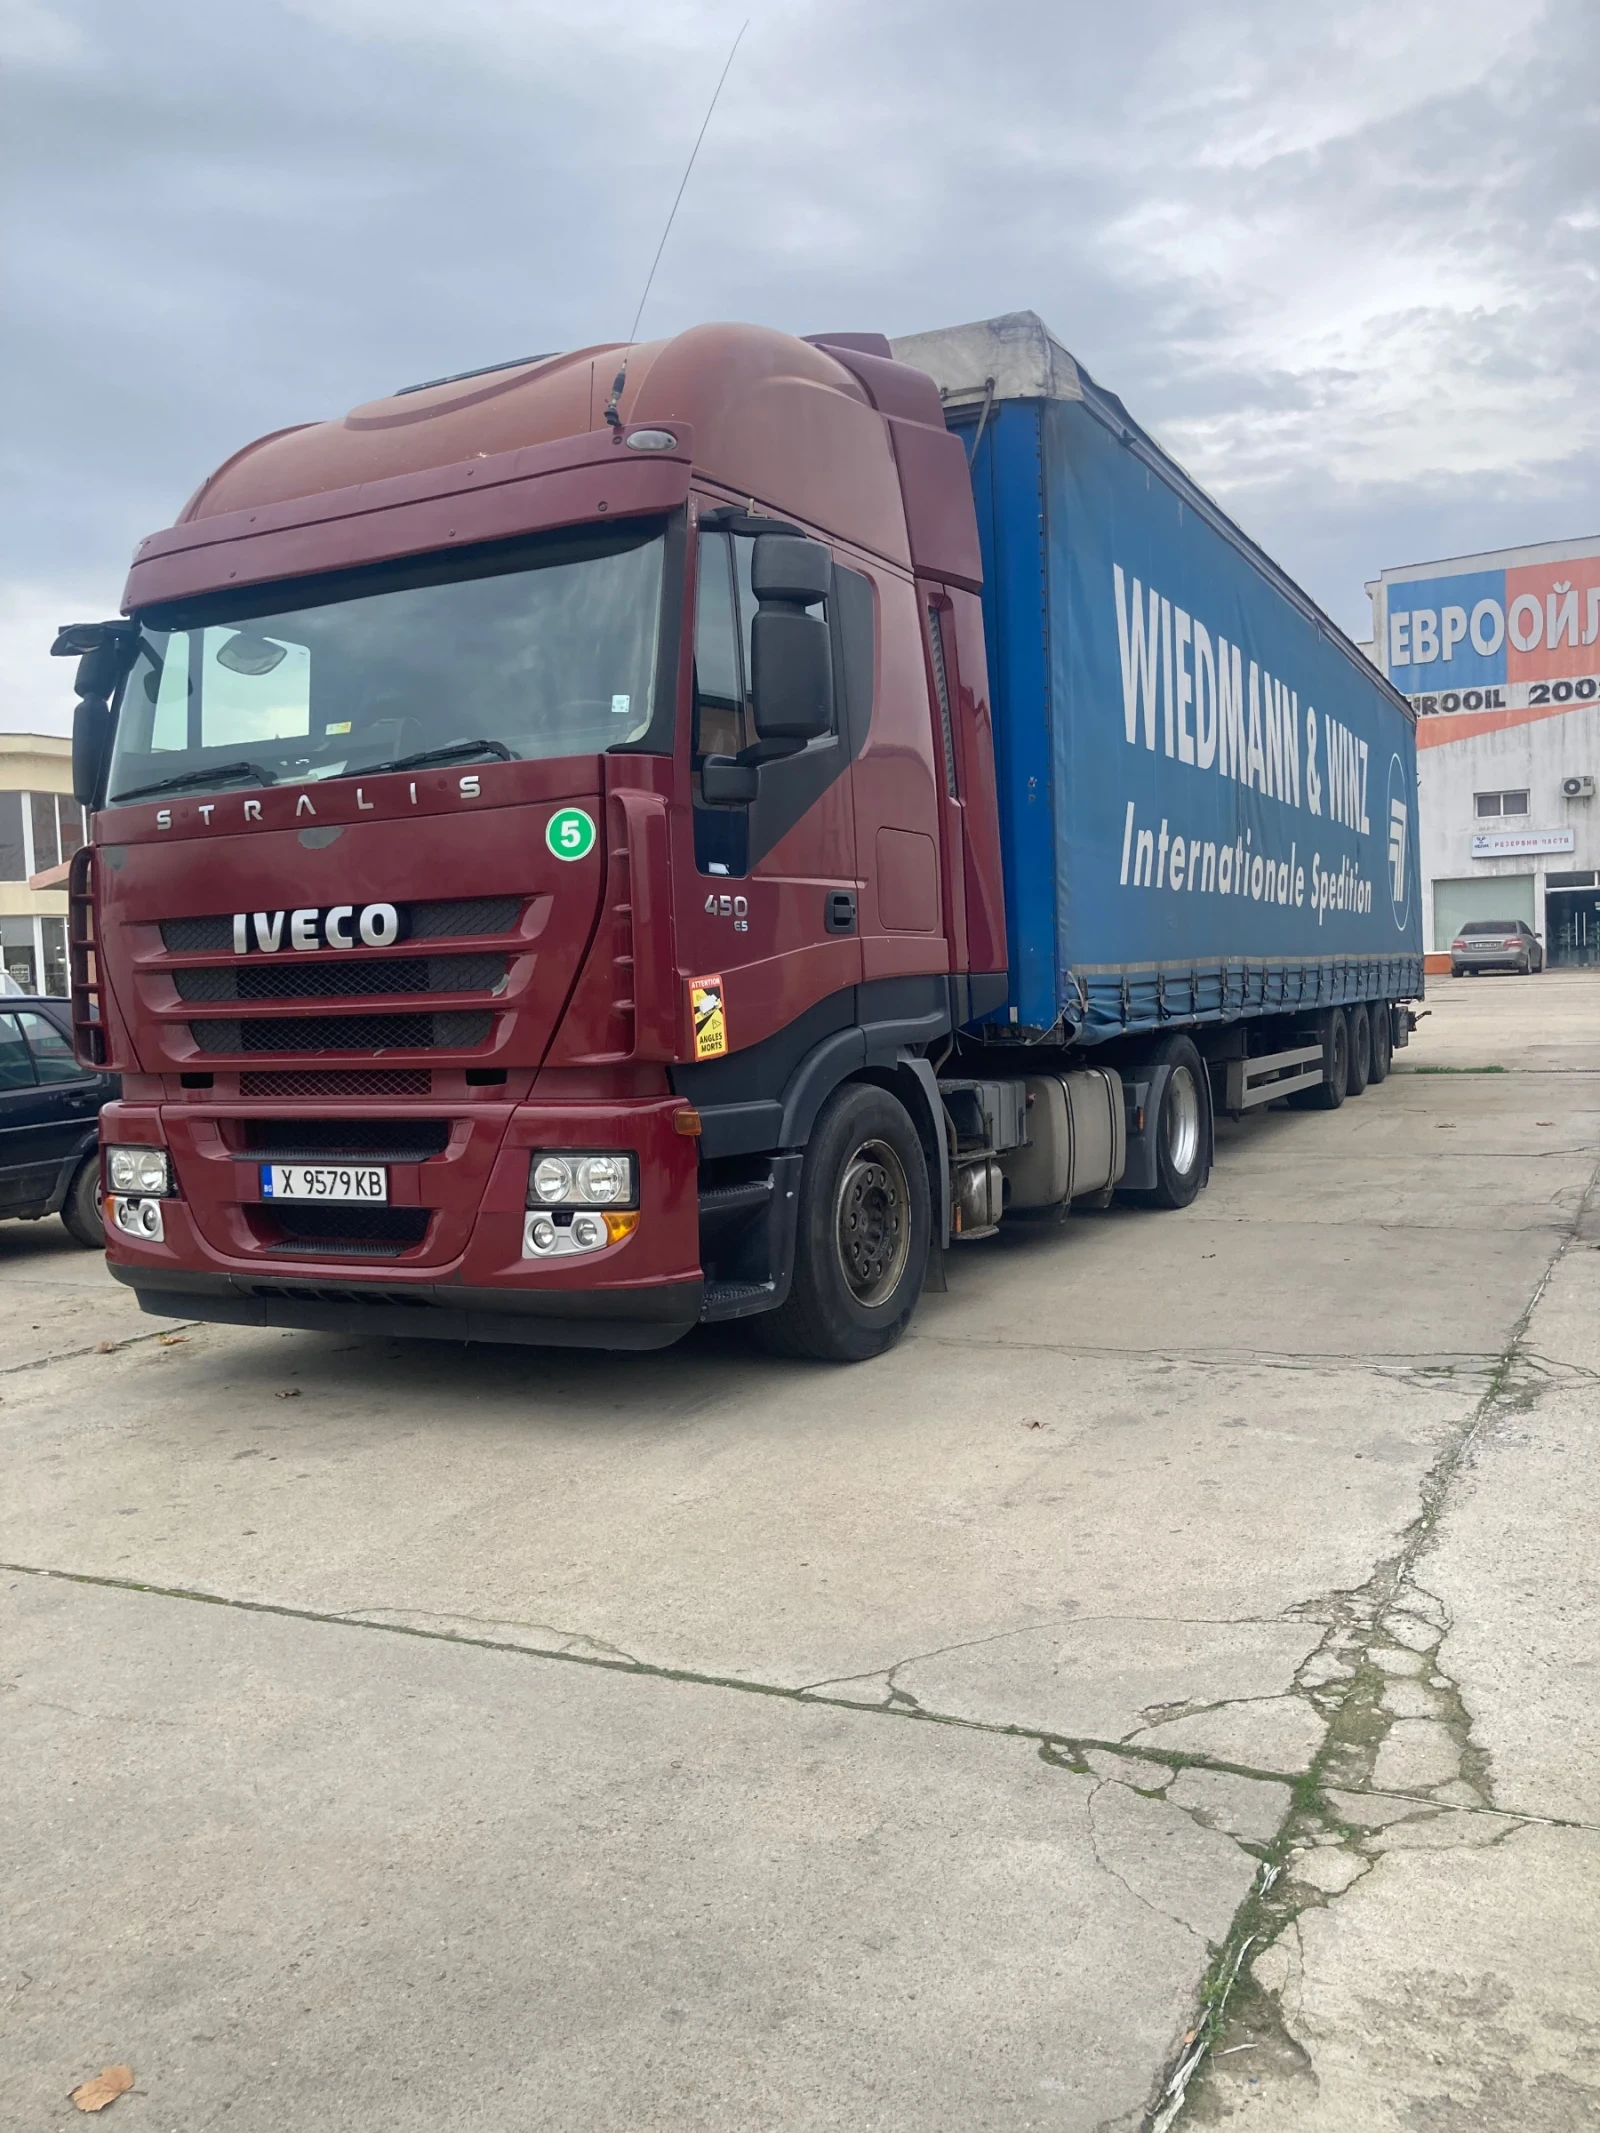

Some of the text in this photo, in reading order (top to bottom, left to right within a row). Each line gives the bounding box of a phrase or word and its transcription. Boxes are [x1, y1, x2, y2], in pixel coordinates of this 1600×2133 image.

[1113, 562, 1370, 836] WIEDMANN & WINZ
[1528, 678, 1600, 706] 200
[156, 775, 481, 831] STRALIS
[560, 819, 581, 848] 5
[1119, 801, 1371, 926] Internationale Spedition
[704, 894, 748, 917] 450
[233, 902, 399, 955] IVECO
[733, 920, 749, 932] E5
[691, 977, 721, 989] ATTENTION
[699, 1032, 723, 1045] ANGLES
[701, 1041, 723, 1053] MORTS
